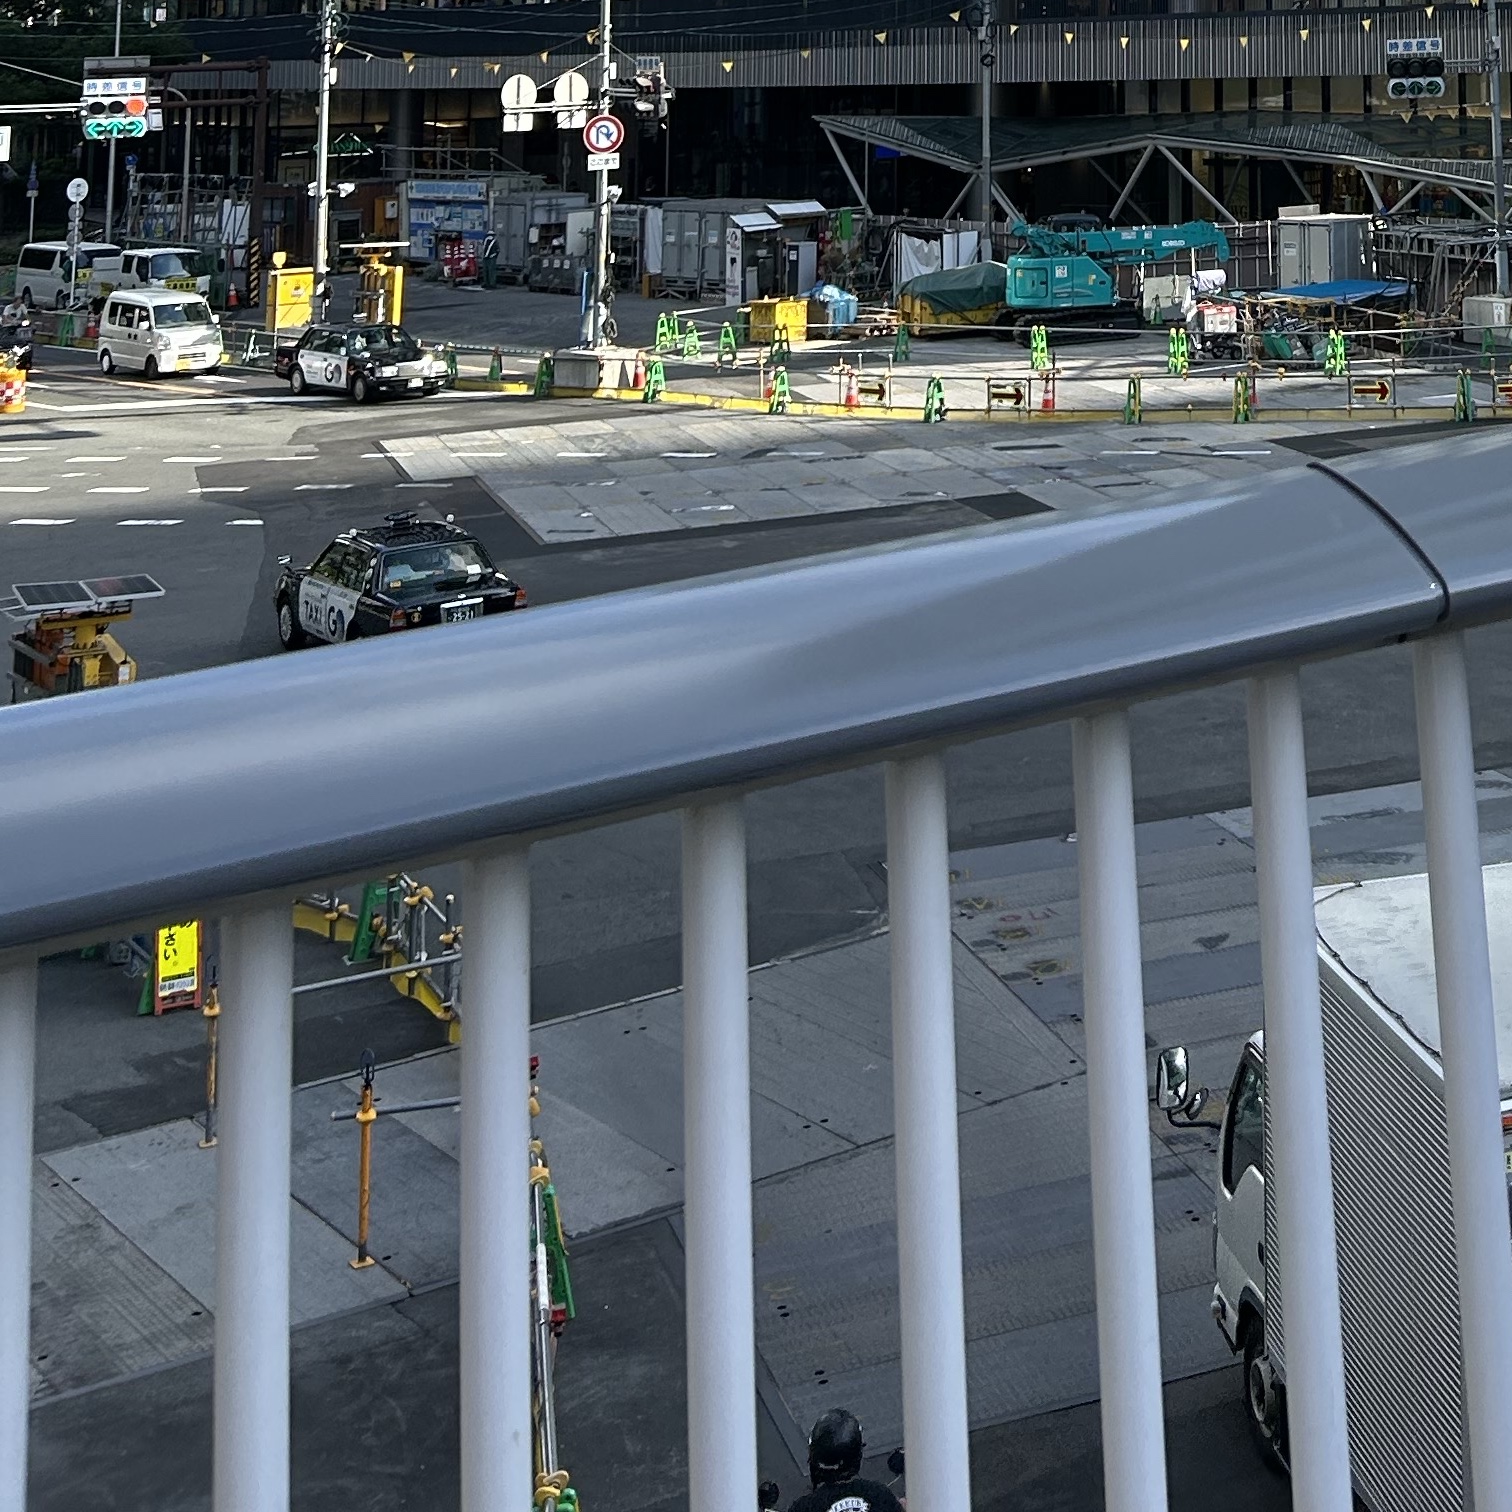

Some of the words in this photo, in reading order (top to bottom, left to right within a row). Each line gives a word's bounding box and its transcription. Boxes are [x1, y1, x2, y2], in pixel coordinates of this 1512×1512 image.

[1388, 40, 1441, 53] 時差信号
[164, 926, 178, 961] さい
